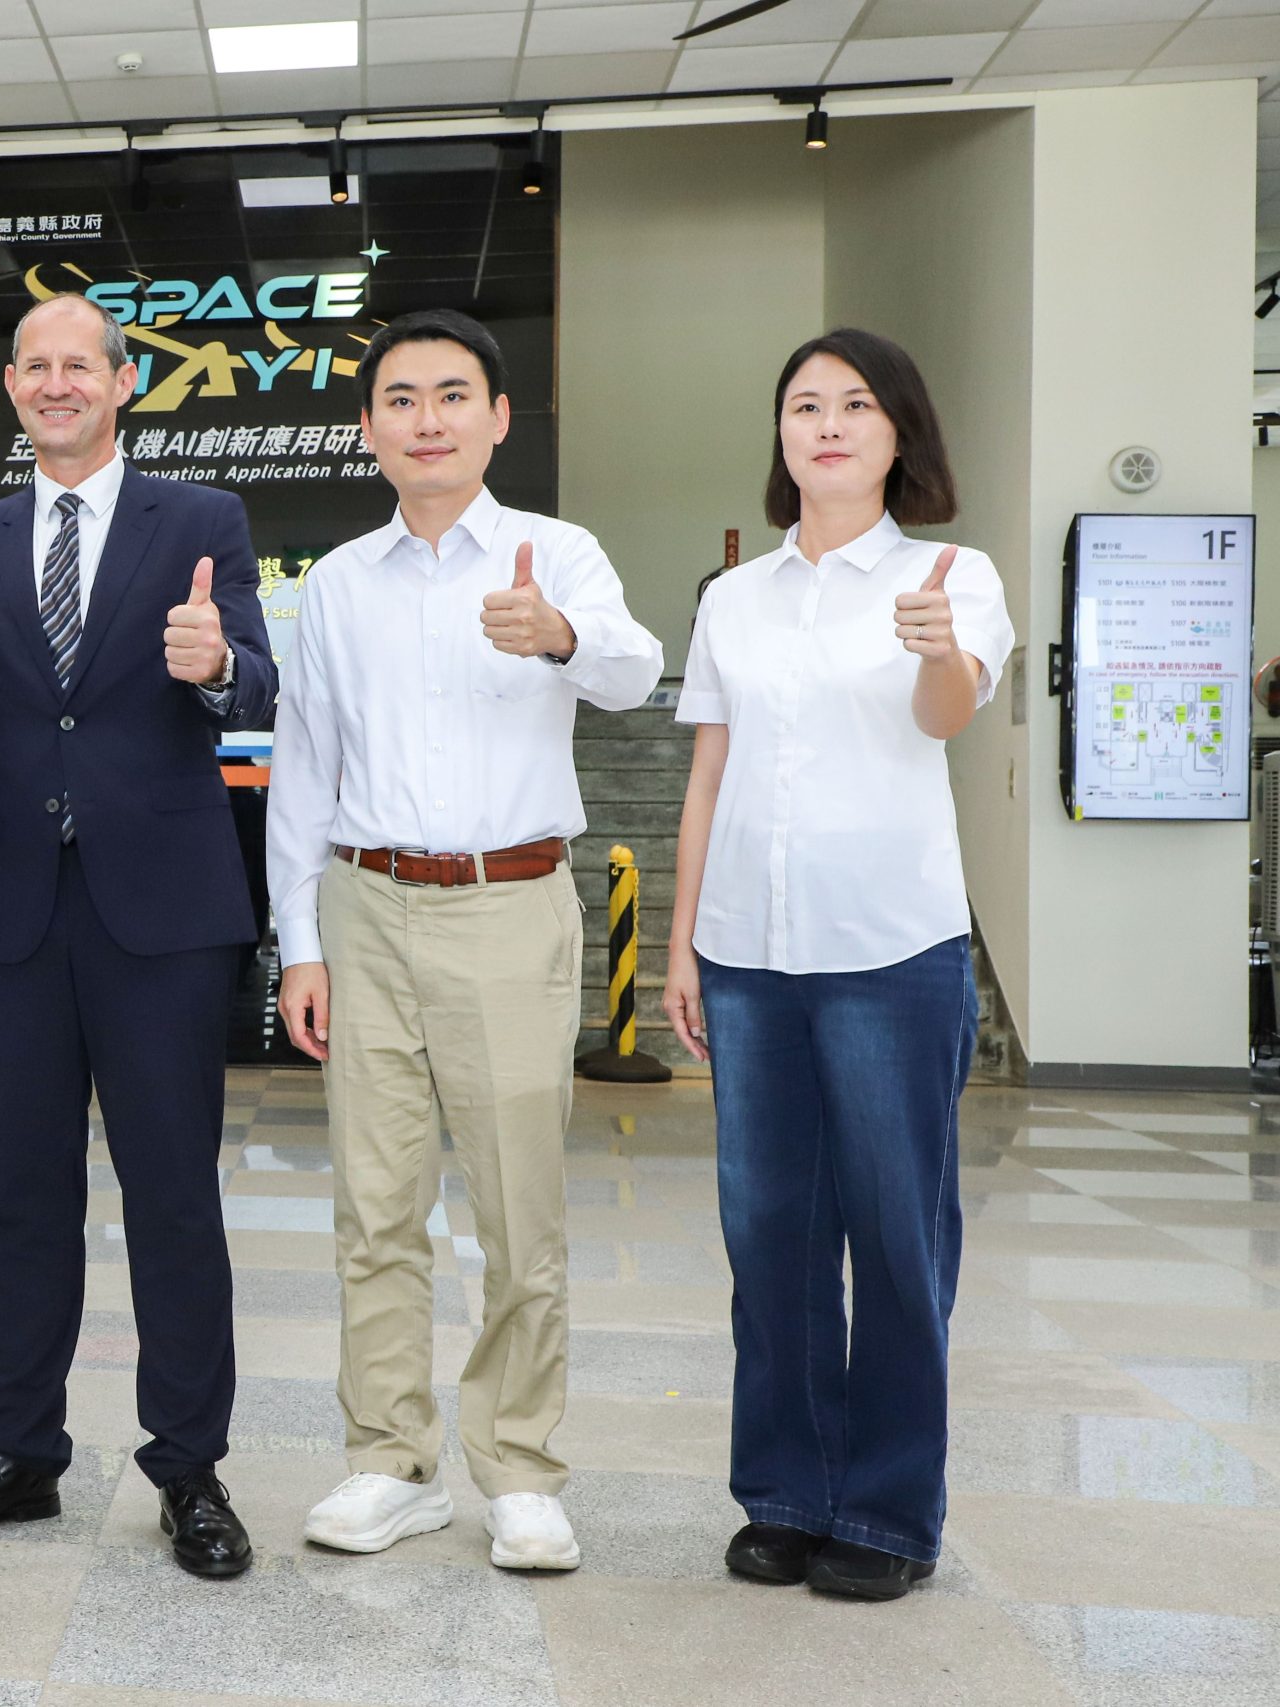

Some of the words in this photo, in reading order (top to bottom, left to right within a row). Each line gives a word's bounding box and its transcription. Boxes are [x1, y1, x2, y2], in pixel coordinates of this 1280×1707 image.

[20, 233, 50, 242] County
[52, 231, 102, 240] Government
[84, 272, 369, 325] SPACE
[225, 462, 331, 485] Application
[341, 462, 380, 478] R&D
[1202, 529, 1237, 560] 1F
